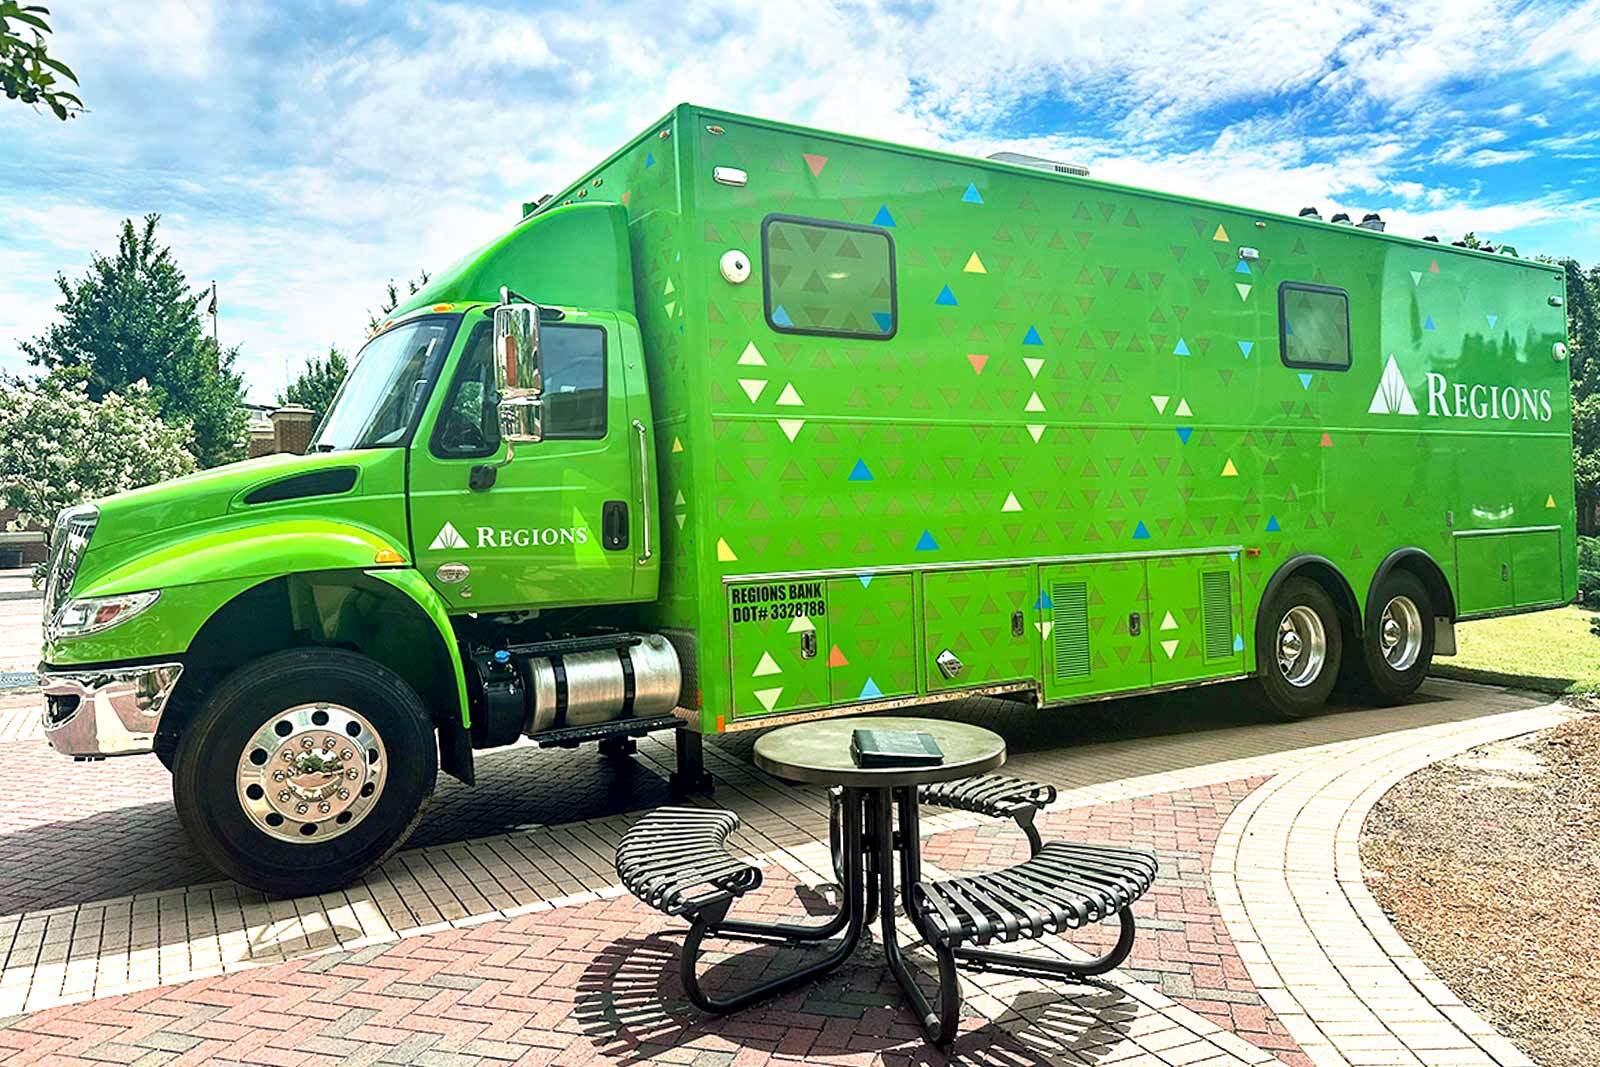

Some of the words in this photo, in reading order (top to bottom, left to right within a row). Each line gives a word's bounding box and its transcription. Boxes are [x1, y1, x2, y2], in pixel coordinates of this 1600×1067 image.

[1425, 372, 1552, 422] REGIONS
[476, 526, 588, 548] REGIONS
[732, 585, 786, 604] REGIONS
[789, 583, 822, 599] BANK
[733, 605, 768, 623] DOT#
[770, 600, 825, 620] 3328788
